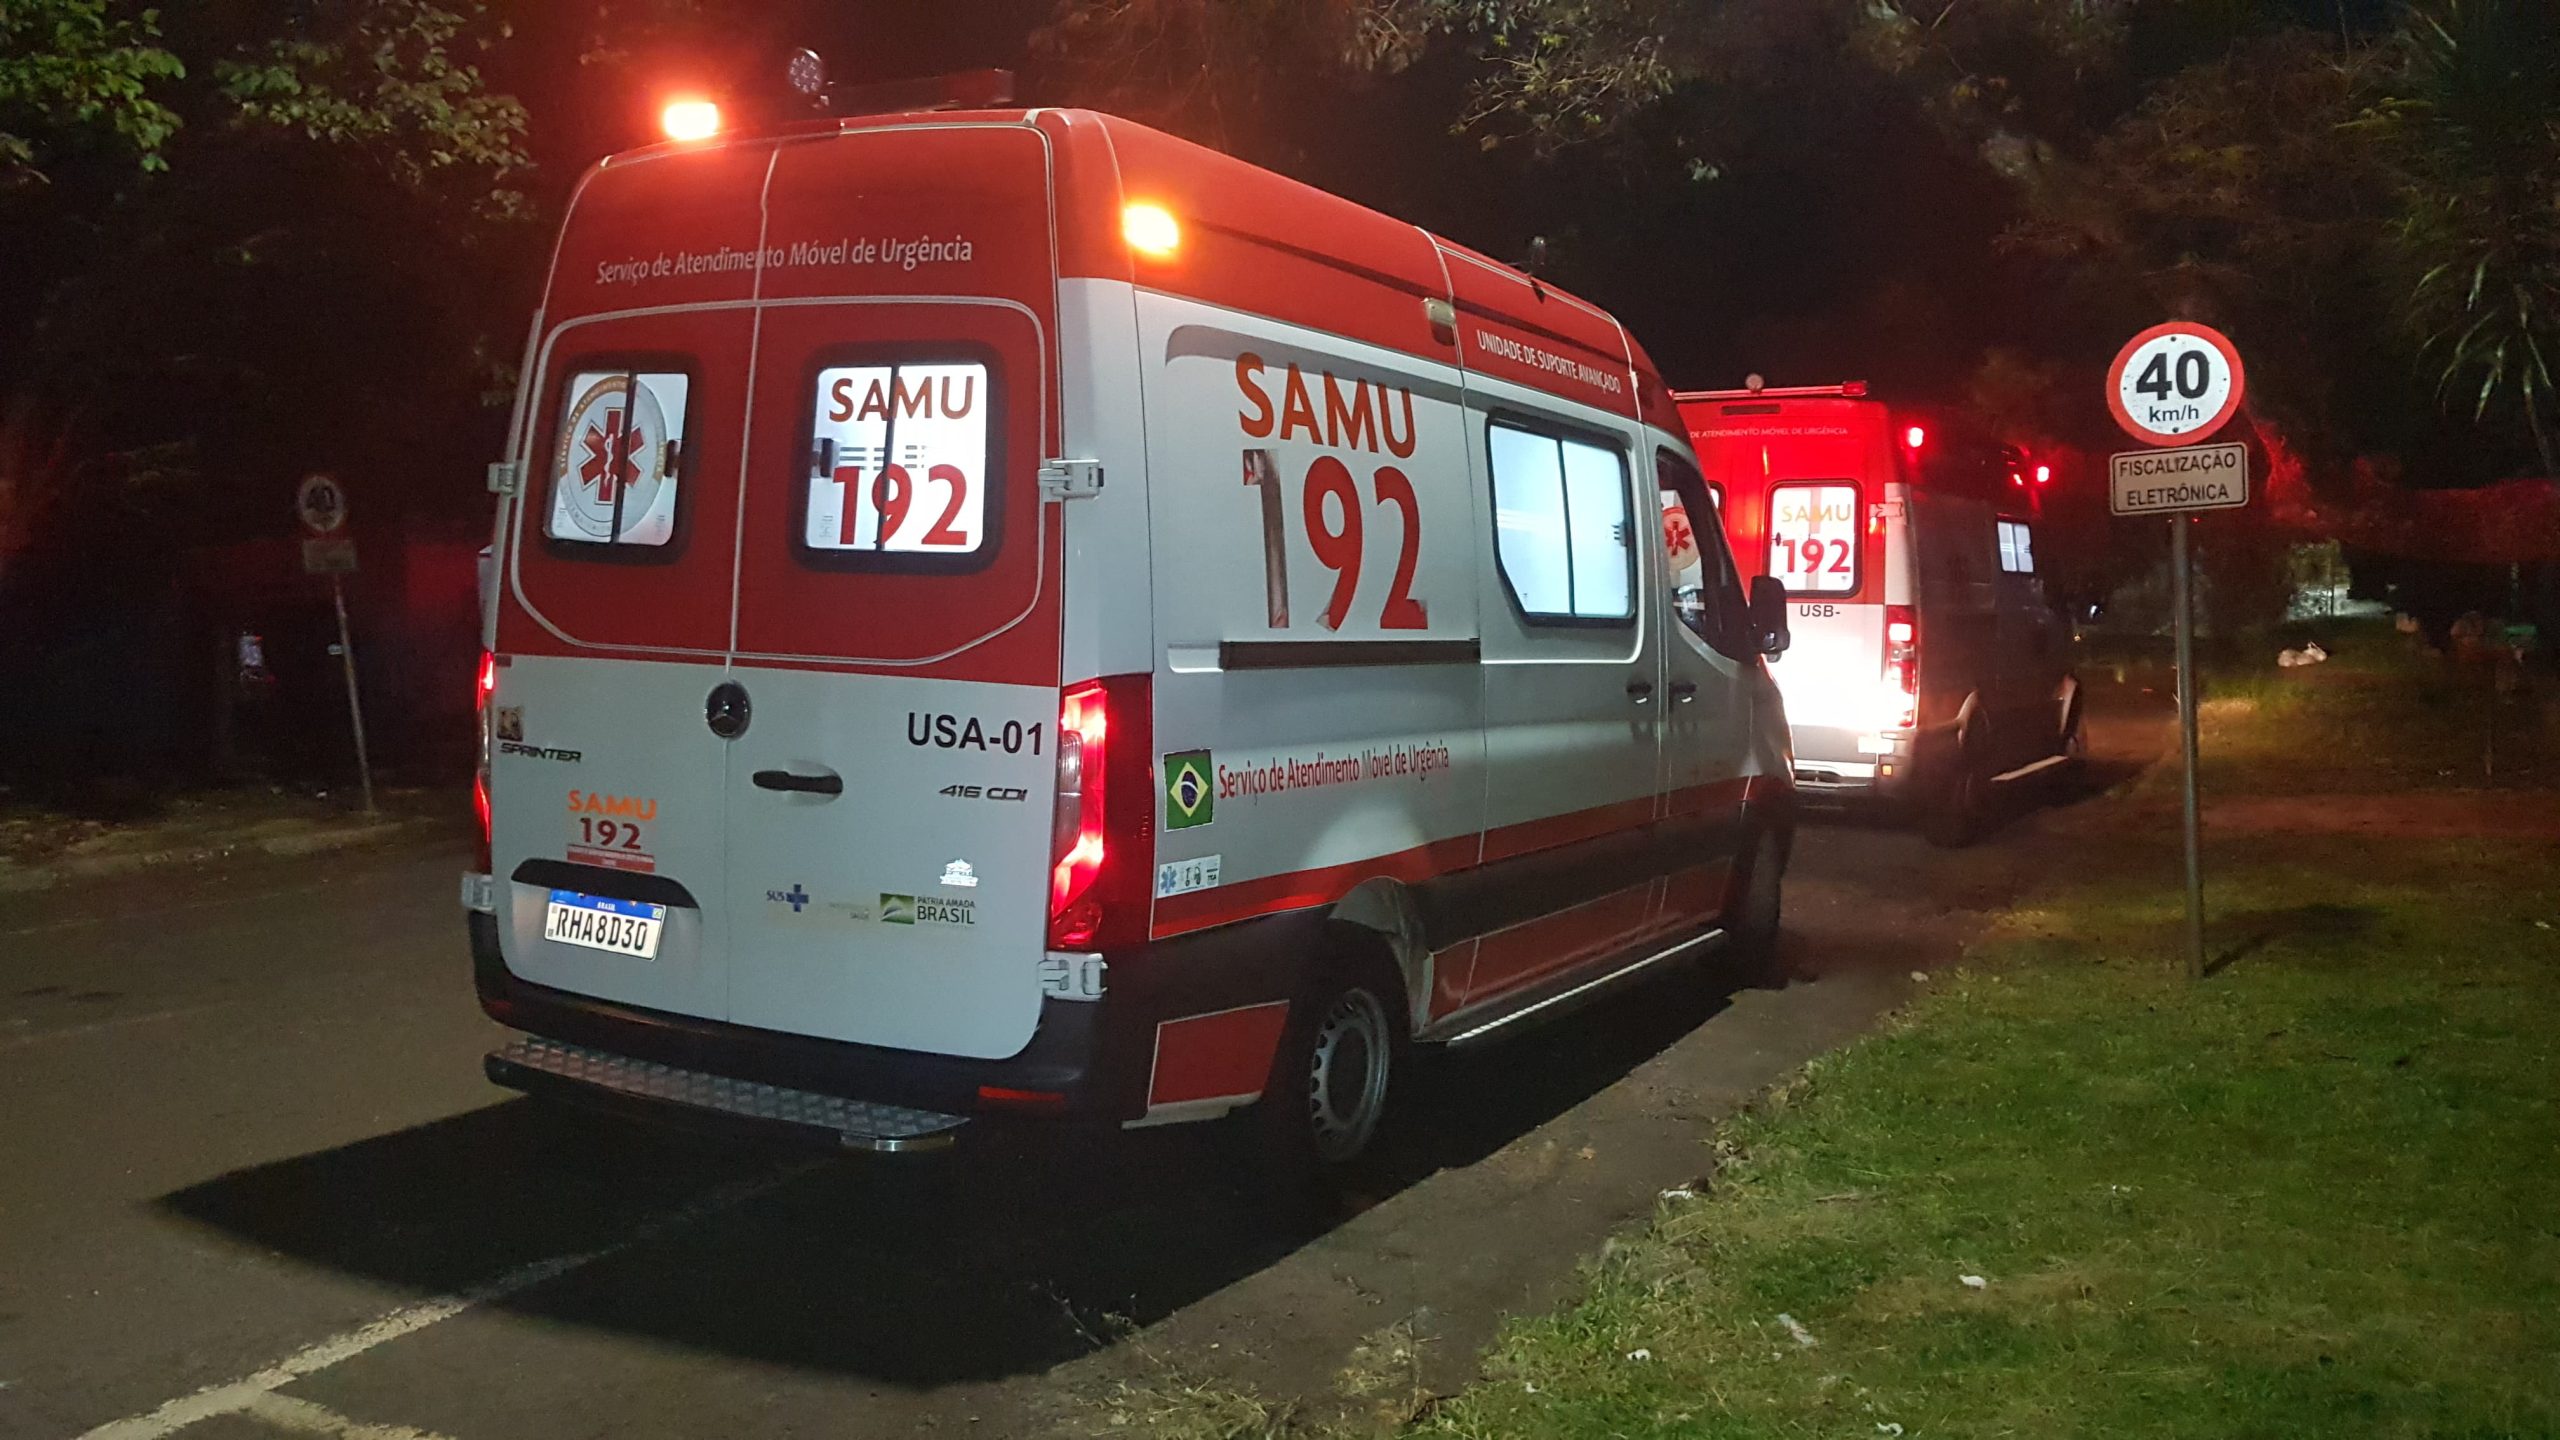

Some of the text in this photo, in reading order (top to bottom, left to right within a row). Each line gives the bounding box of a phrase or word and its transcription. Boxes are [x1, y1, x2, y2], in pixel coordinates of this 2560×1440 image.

[596, 234, 972, 286] Serviço de Atendimento Móvel de Urgência
[1477, 329, 1621, 394] UNIDADE DE SUPORTE AVANÇADO
[2136, 349, 2210, 401] 40
[829, 376, 975, 423] SAMU
[1235, 352, 1416, 459] SAMU
[2149, 405, 2199, 423] km/h
[1701, 428, 1760, 438] ATENDIMENTO
[1803, 425, 1848, 436] URGÊNCIA
[2120, 450, 2236, 477] FISCALIZAÇÃO
[833, 464, 968, 546] 192
[2127, 483, 2229, 506] ELETRÔNICA
[1781, 504, 1851, 523] SAMU
[1243, 449, 1428, 632] 192
[1781, 539, 1851, 573] 192
[1800, 605, 1840, 617] USB-
[908, 712, 1042, 755] USA-01
[500, 742, 581, 763] SPRINTER
[1219, 739, 1449, 806] Serviço de Atendimento Móvel de Urgência
[567, 789, 657, 821] SAMU
[939, 784, 1028, 801] 416 CDI
[580, 818, 641, 850] 192
[766, 890, 785, 902] SUS
[945, 898, 976, 909] AMADA
[556, 908, 648, 951] RHA8D30
[917, 905, 976, 925] BRASIL
